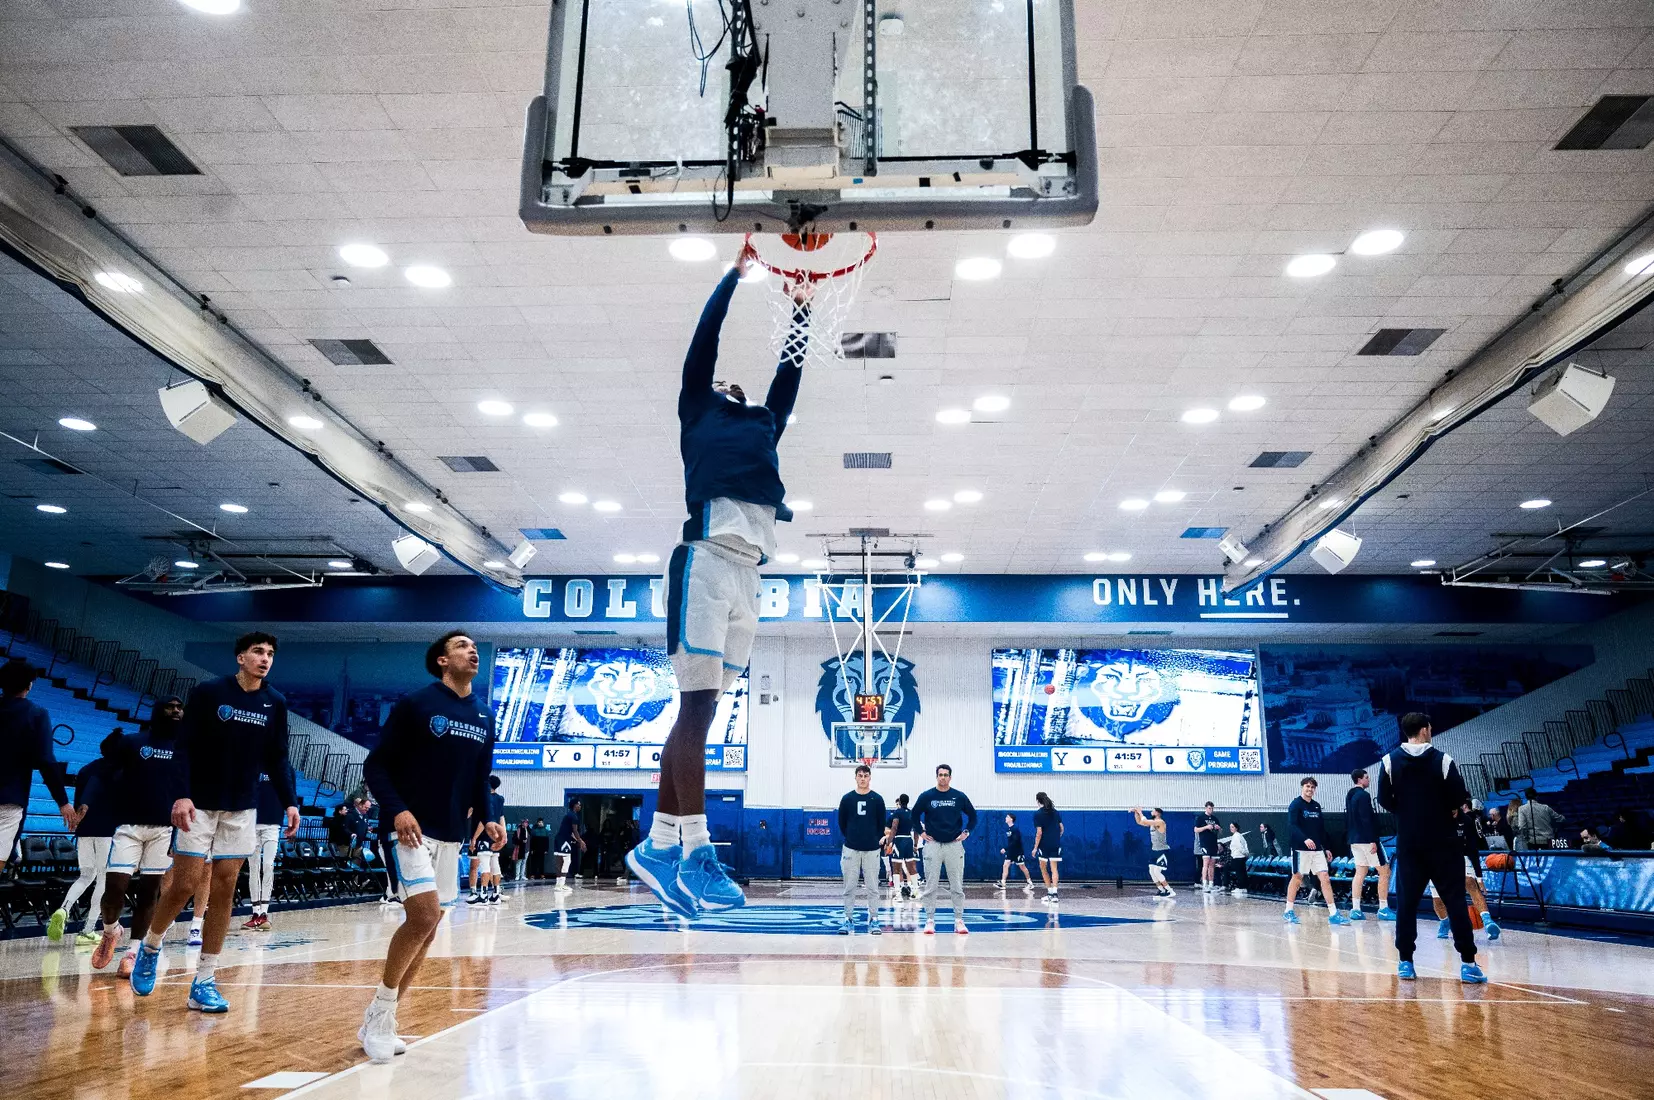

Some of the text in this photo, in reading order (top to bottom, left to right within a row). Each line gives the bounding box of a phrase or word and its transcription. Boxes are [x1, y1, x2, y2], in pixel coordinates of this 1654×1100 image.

[1092, 578, 1178, 606] ONLY
[449, 720, 487, 736] COLUMBIA
[450, 730, 485, 743] BASKETBALL
[546, 749, 559, 762] Y
[573, 752, 581, 761] 0
[1054, 752, 1068, 766] Y
[1083, 755, 1092, 764] 0
[1165, 755, 1174, 765] 0
[857, 801, 866, 815] C
[806, 827, 831, 835] HOSE
